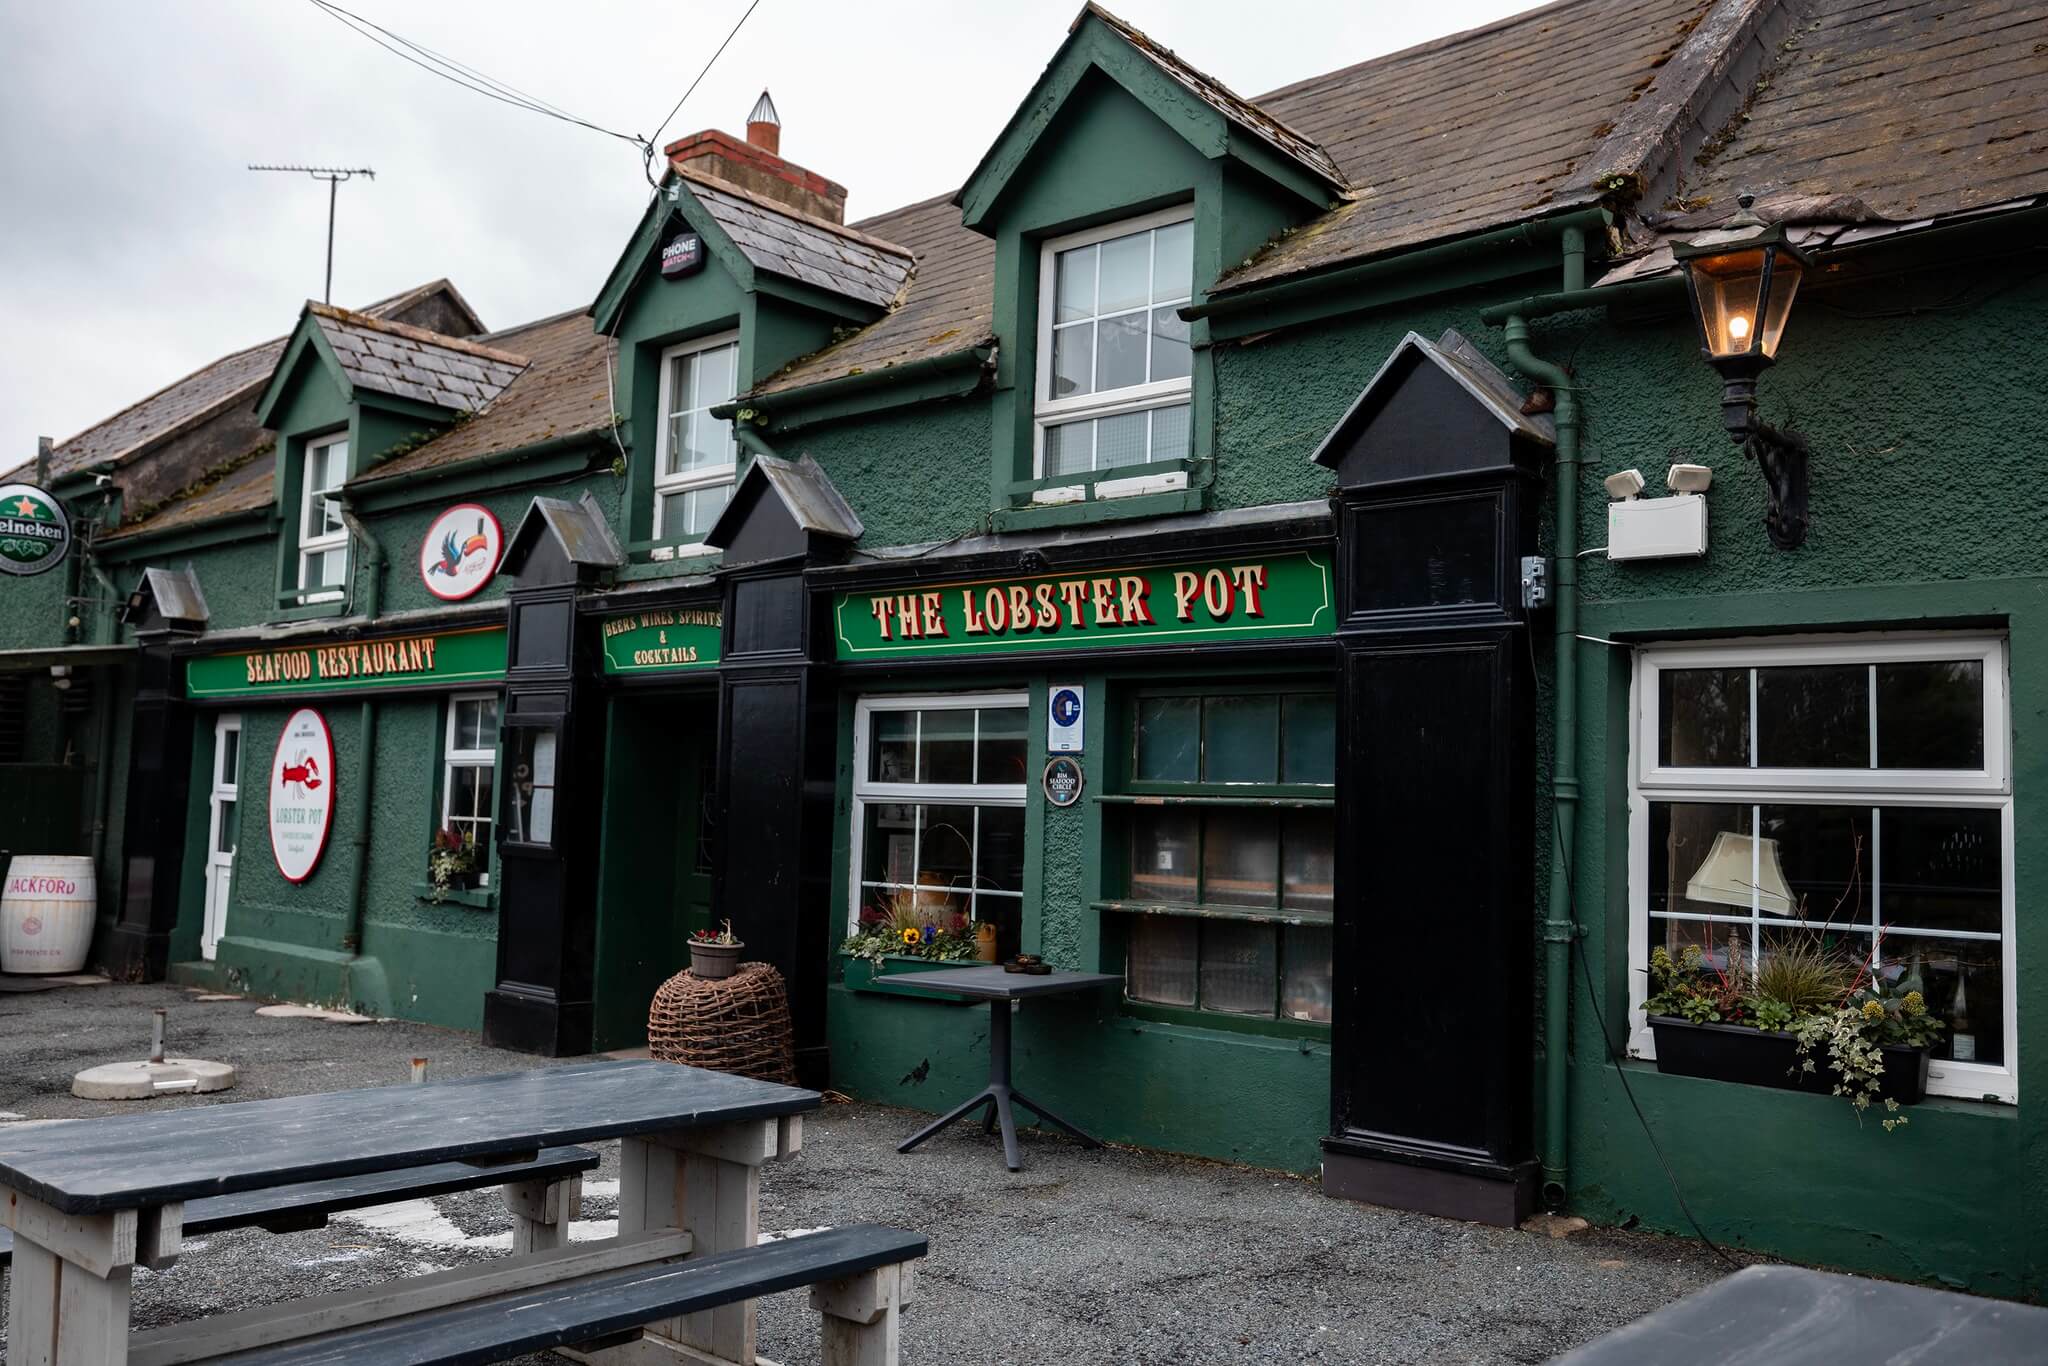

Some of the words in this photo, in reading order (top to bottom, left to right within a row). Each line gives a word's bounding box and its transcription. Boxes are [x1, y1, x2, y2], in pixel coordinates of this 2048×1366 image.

[662, 239, 696, 259] PHONE
[0, 519, 62, 539] eineken
[871, 592, 948, 641] THE
[962, 575, 1157, 634] LOBSTER
[1173, 565, 1268, 619] POT
[605, 617, 637, 637] BEERS
[641, 611, 674, 628] WINES
[679, 610, 722, 628] SPIRITS
[660, 630, 667, 644] &
[246, 652, 312, 683] SEAFOOD
[317, 638, 435, 678] RESTAURANT
[634, 647, 697, 664] COCKTAILS
[276, 808, 305, 825] LOBSTER
[308, 808, 323, 825] POT
[8, 879, 76, 895] JACKFORD
